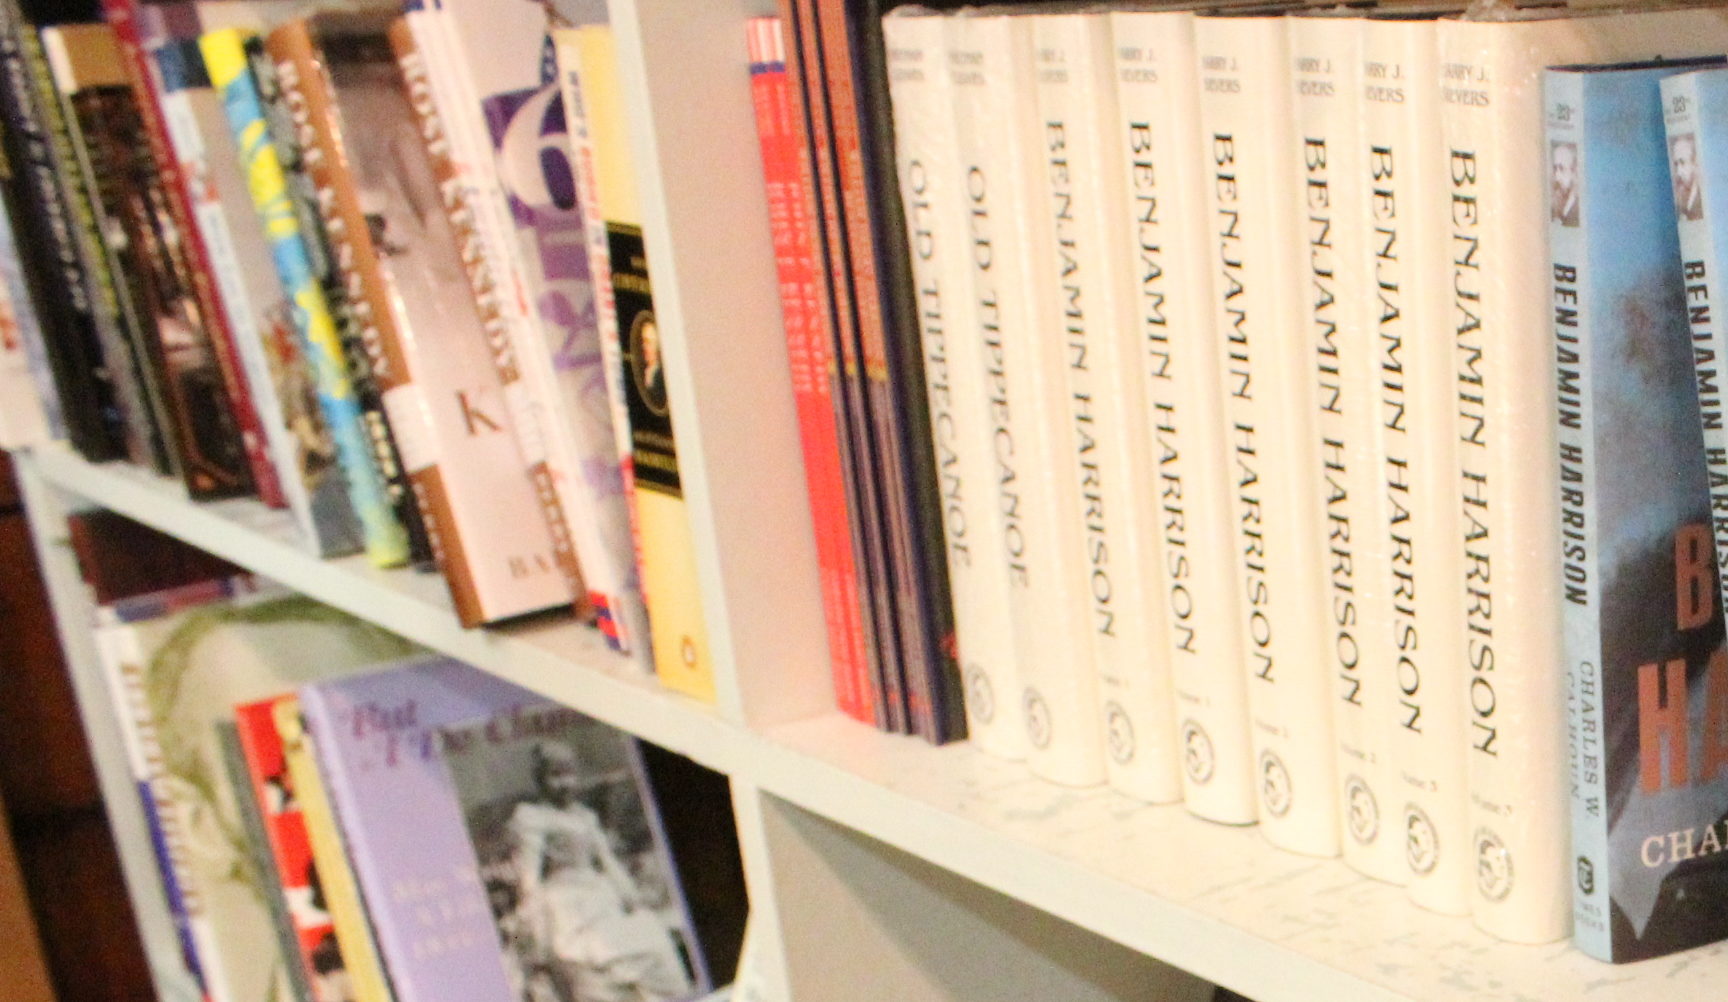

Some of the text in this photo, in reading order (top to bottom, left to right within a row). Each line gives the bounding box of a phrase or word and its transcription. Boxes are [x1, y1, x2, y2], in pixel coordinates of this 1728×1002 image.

[908, 158, 972, 570] OLD TIPPECANOE
[967, 164, 1030, 589] OLD TIPPECANOE
[1045, 120, 1089, 374] BENJAMIN
[1073, 392, 1117, 638] HARRISON
[1128, 120, 1173, 382] BENJAMIN
[1154, 400, 1197, 656] HARRISON
[1212, 131, 1254, 402] BENJAMIN
[1233, 421, 1276, 684] HARRISON
[1303, 135, 1343, 417] BENJAMIN
[1369, 144, 1409, 437] BENJAMIN
[1448, 147, 1488, 451] BENJAMIN
[1683, 259, 1723, 431] BENJAMIN
[1320, 436, 1363, 709] HARRISON
[1552, 262, 1589, 606] BENJAMIN HARRISON
[1384, 455, 1423, 735] HARRISON
[1460, 468, 1500, 758] HARRISON
[1579, 660, 1599, 786] CHARLES
